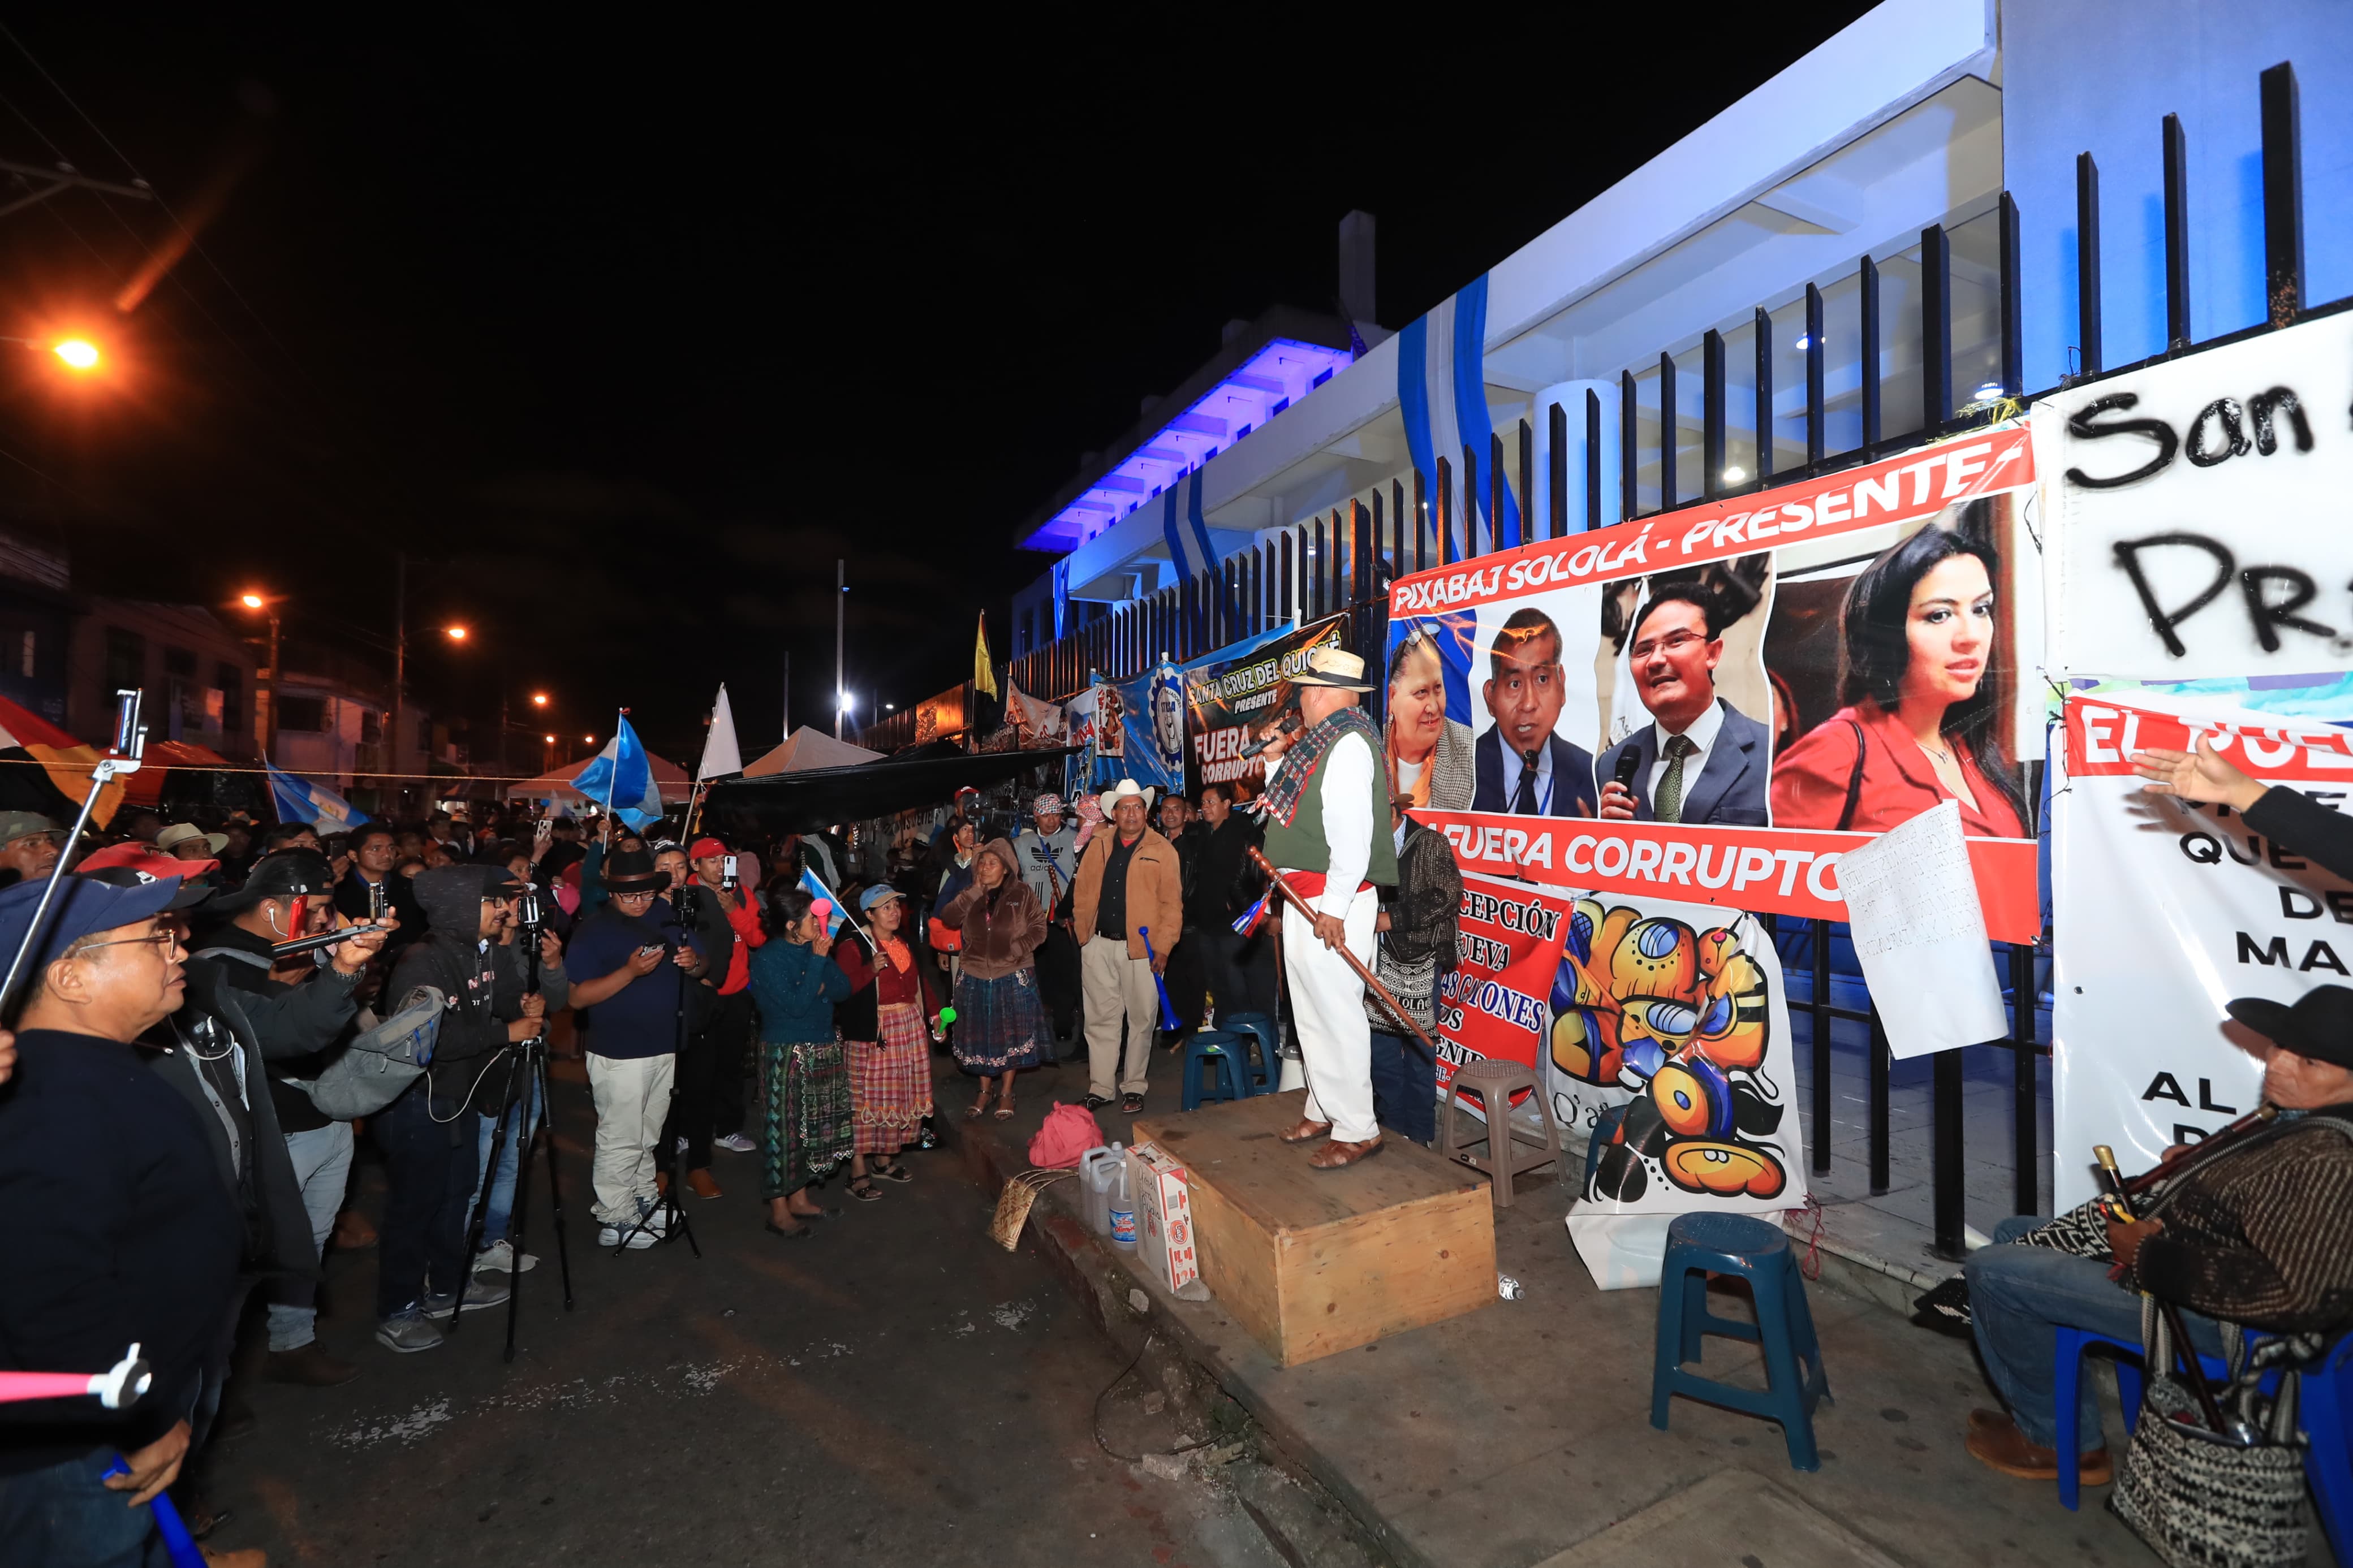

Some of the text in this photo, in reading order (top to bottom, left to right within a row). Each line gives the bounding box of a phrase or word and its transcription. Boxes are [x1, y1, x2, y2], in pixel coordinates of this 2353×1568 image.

[2065, 386, 2314, 490] San
[1394, 565, 1503, 612] PIXABAJ
[1507, 522, 1651, 588] SOLOLÁ
[1682, 442, 2005, 555] PRESENTE
[1188, 680, 1223, 707] SANTA
[1223, 669, 1256, 697] CRUZ
[1255, 659, 1281, 690] DEL
[1234, 688, 1277, 714] PRESENTE
[1194, 723, 1251, 764] FUERA
[2081, 705, 2146, 763] EL
[1425, 823, 1553, 870] FUERA
[2179, 831, 2307, 870] QUE
[2141, 1071, 2237, 1116] AL
